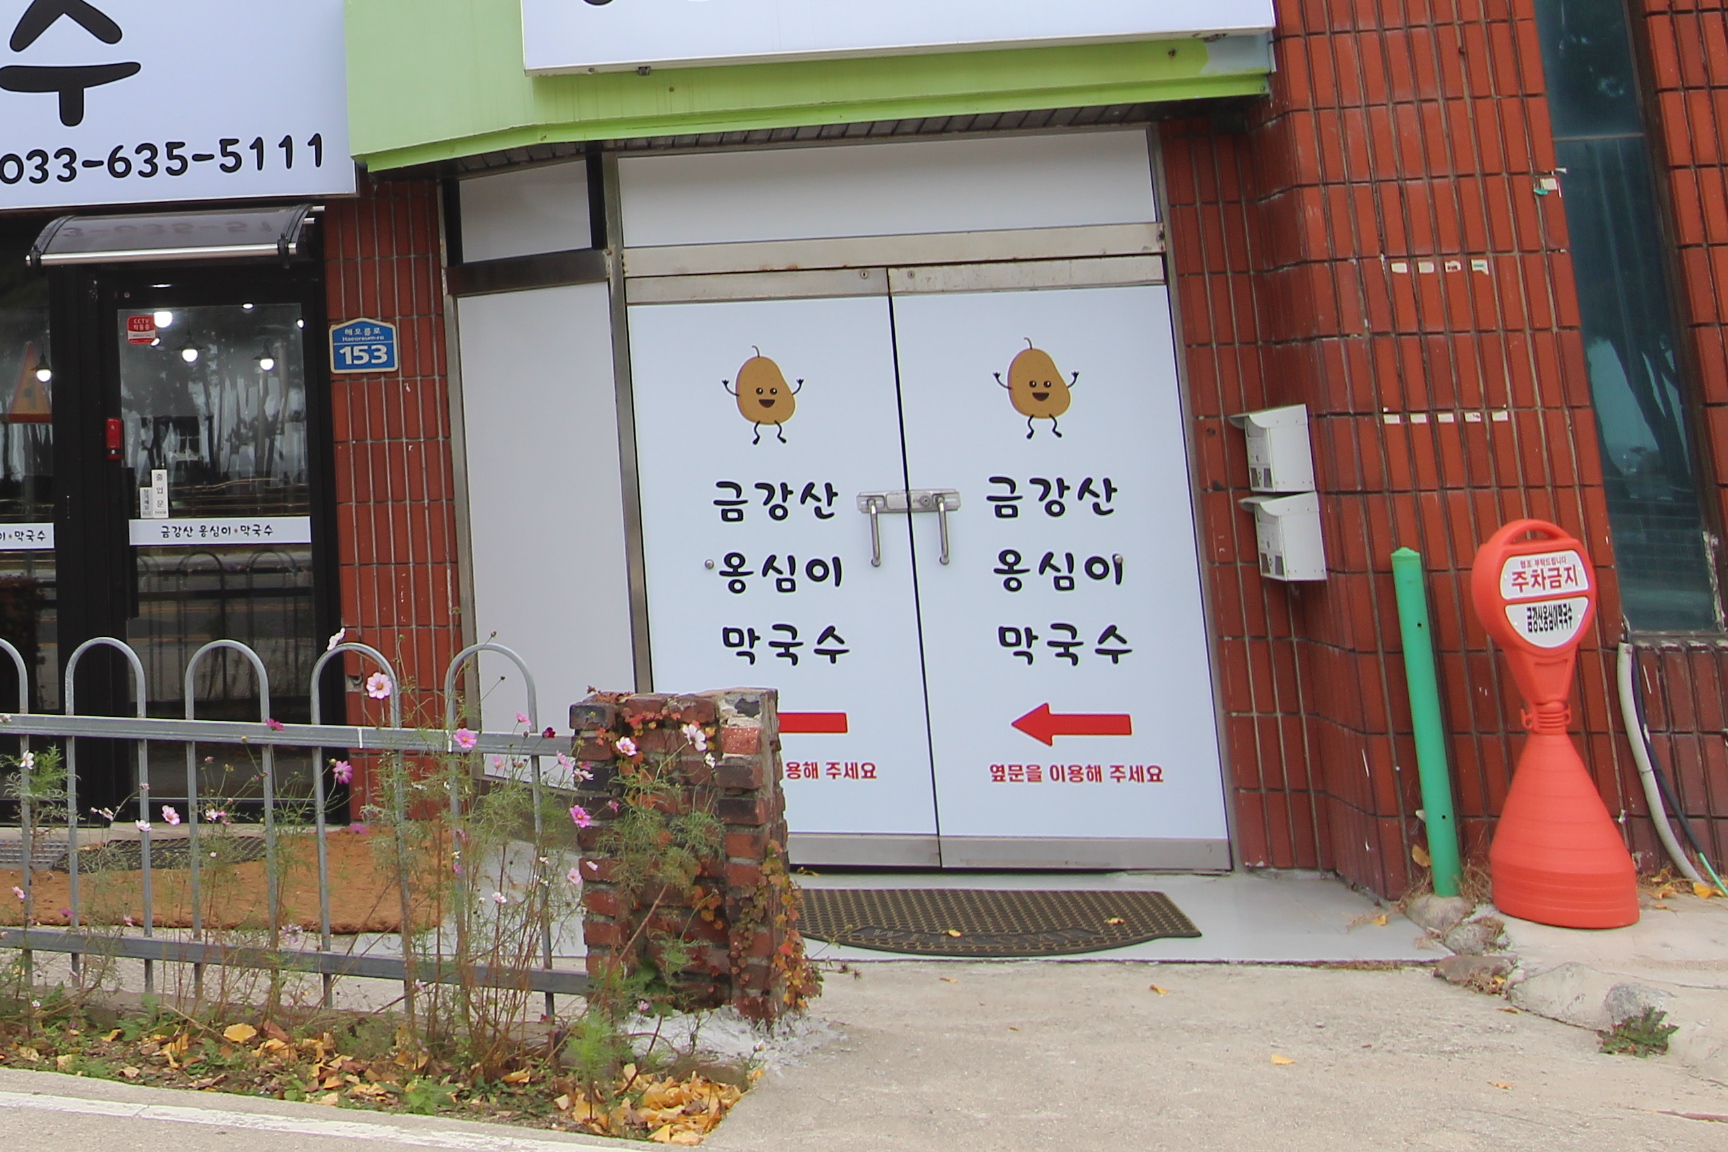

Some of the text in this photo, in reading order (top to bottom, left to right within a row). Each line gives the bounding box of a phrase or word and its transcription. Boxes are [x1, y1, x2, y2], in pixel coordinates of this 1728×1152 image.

[339, 344, 388, 365] 153
[713, 480, 839, 523] 금강산
[986, 476, 1118, 519] 금강산
[14, 529, 46, 543] 막국수
[161, 523, 273, 539] 금강산 옹심이 막국수
[718, 552, 842, 594] 옹심이
[993, 549, 1123, 593] 옹심이
[1511, 564, 1579, 593] 주차금지
[722, 623, 850, 667] 막국수
[998, 622, 1133, 667] 막국수
[785, 761, 877, 780] 용해 주세요
[989, 764, 1164, 783] 옆문을 이용해 주세요
